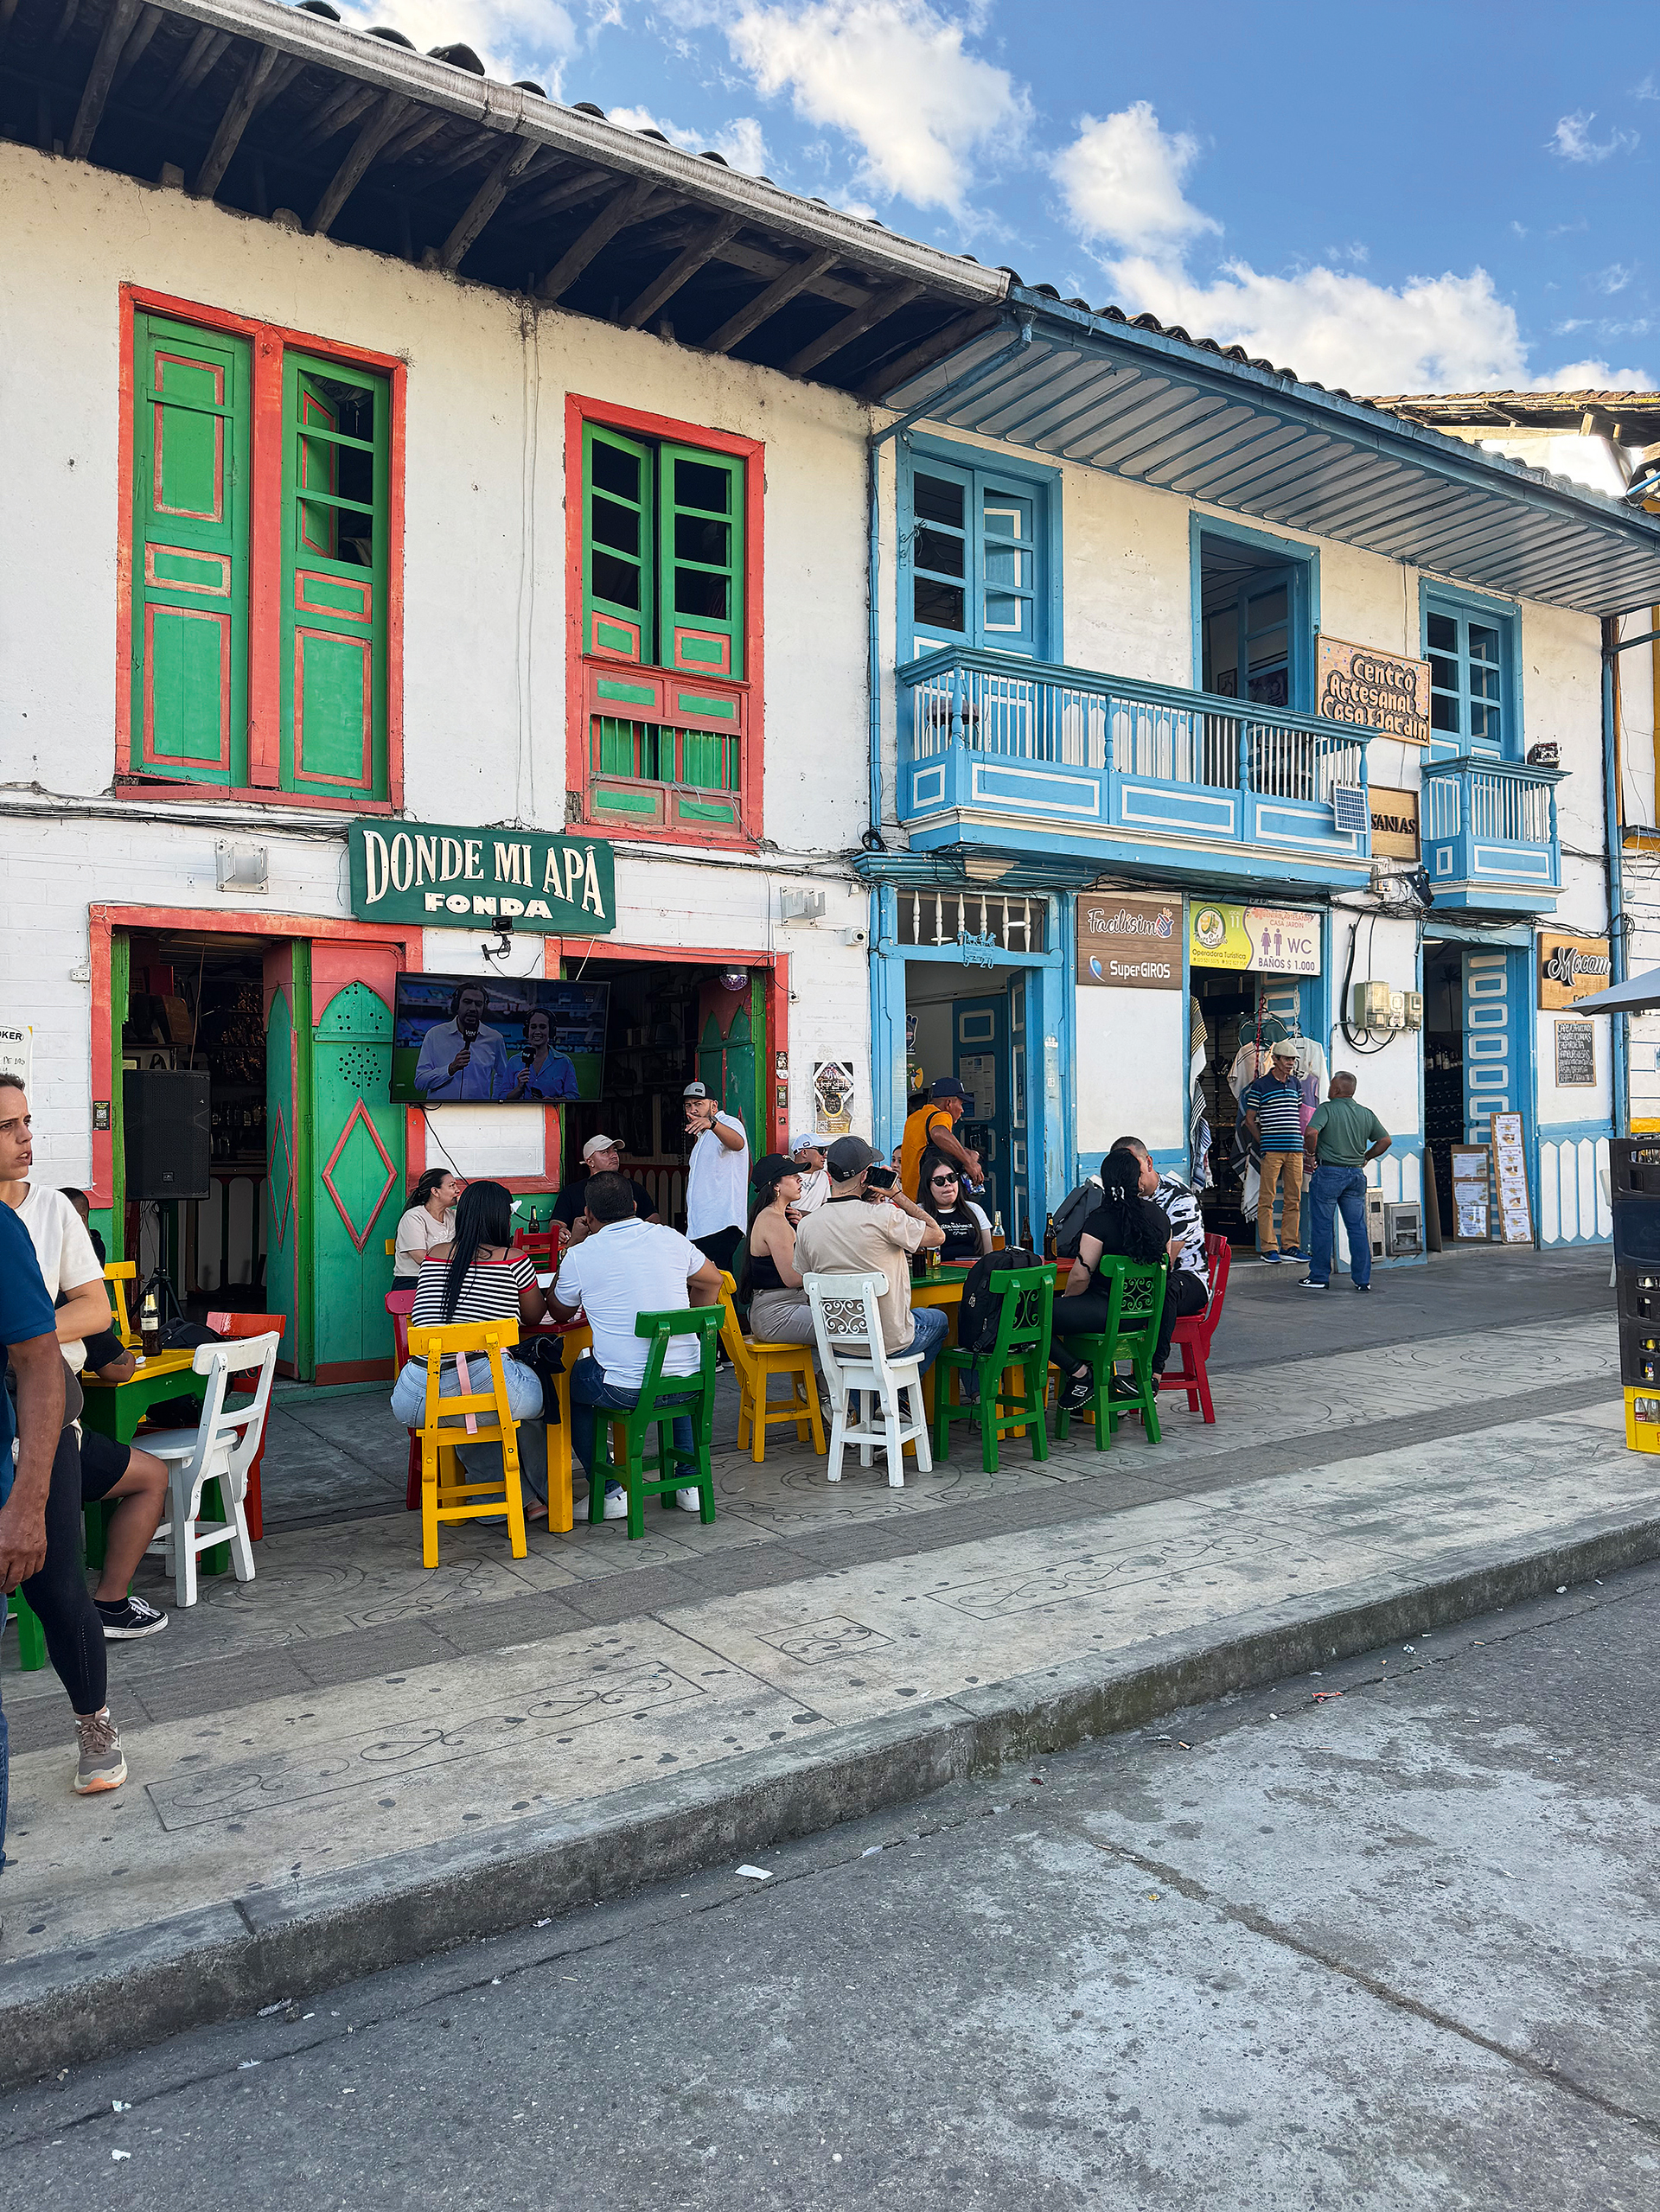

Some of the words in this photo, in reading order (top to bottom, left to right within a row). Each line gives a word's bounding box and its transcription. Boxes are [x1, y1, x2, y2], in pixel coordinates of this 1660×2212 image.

[1353, 658, 1414, 692] Centro
[1323, 696, 1364, 725] Casa
[363, 830, 484, 905] DONDE
[493, 841, 533, 888] MI
[542, 844, 606, 919] APÁ
[425, 892, 554, 919] FONDA
[1230, 915, 1240, 928] 11
[1192, 948, 1223, 959] Operadora
[1287, 937, 1312, 954] WC
[1258, 956, 1286, 969] BAÑOS
[1286, 959, 1293, 970] $
[1294, 960, 1316, 972] 1.000
